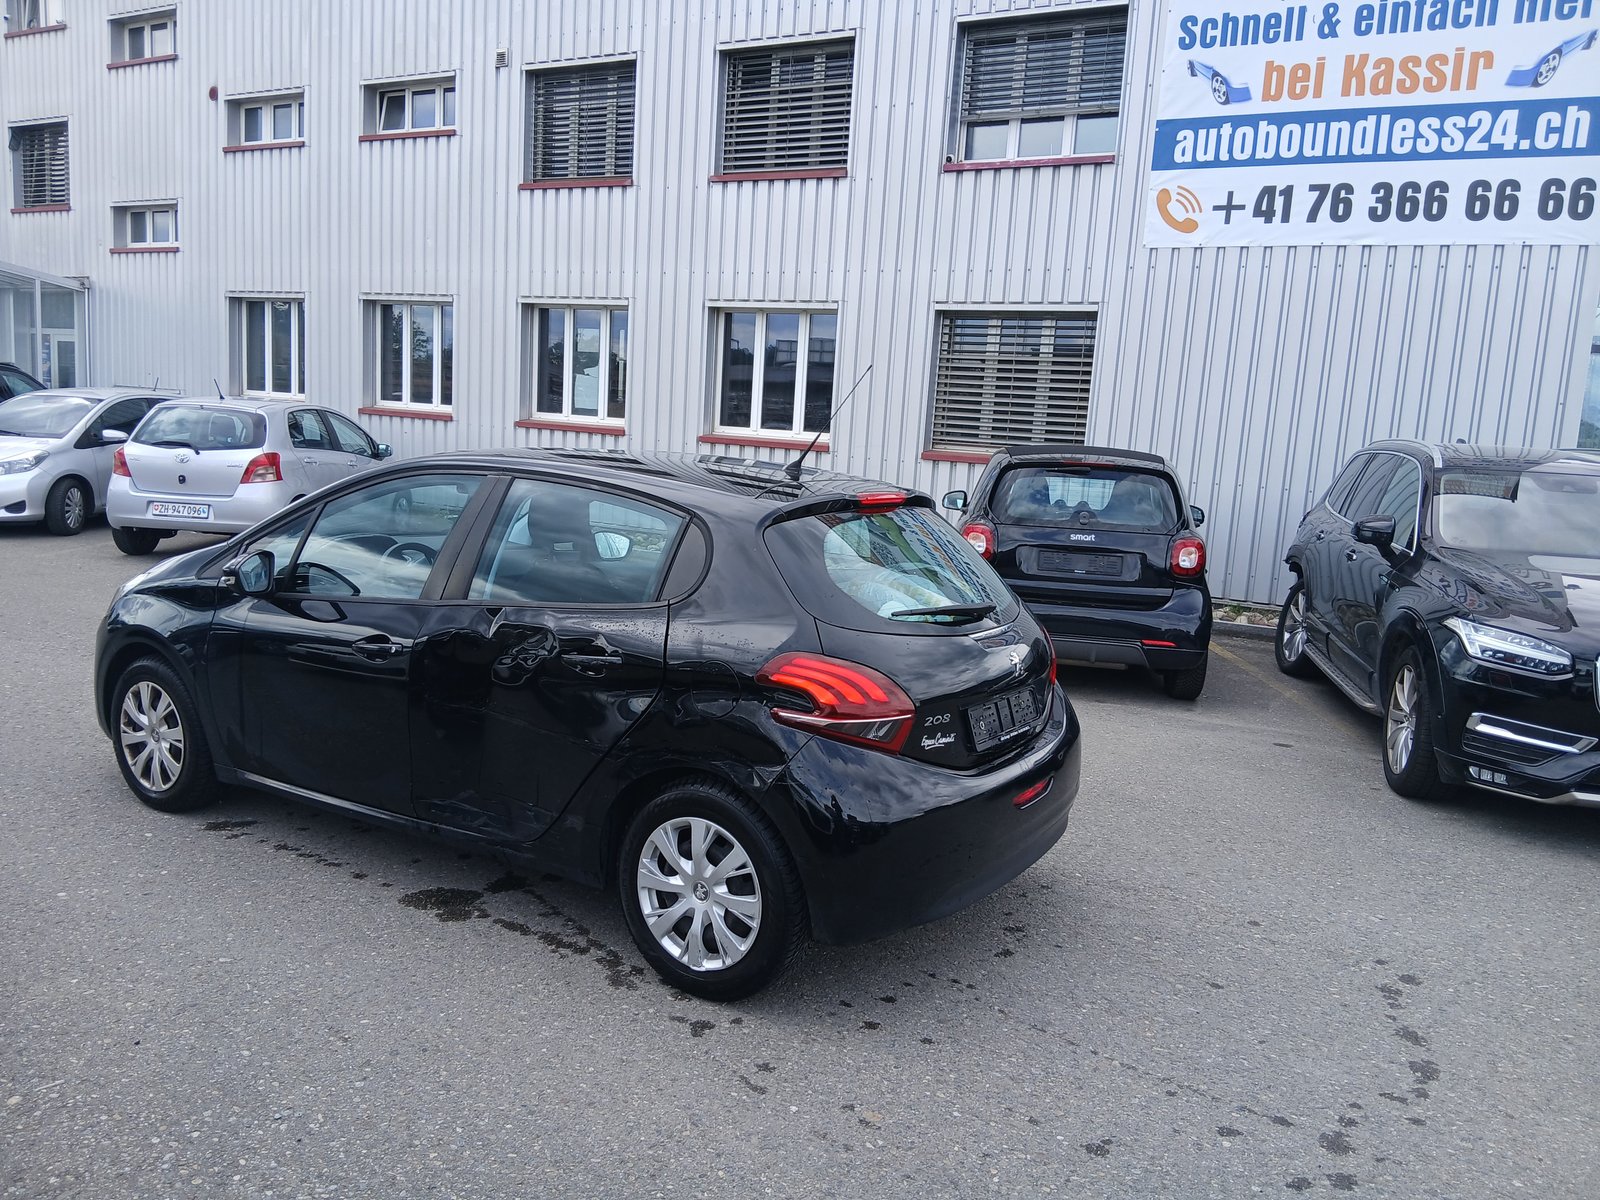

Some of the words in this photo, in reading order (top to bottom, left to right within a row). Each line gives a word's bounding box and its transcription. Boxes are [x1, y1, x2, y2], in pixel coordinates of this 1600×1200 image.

[1178, 6, 1307, 50] Schnell
[1317, 2, 1341, 39] &
[1353, 0, 1500, 36] einfach
[1261, 57, 1326, 102] bei
[1340, 47, 1494, 97] Kassir
[1173, 106, 1591, 162] autoboundless24.ch
[1306, 182, 1355, 223] 76
[1368, 180, 1449, 222] 366
[1465, 179, 1521, 221] 66
[1537, 177, 1597, 221] 66
[1070, 533, 1096, 542] smart
[924, 713, 951, 727] 208
